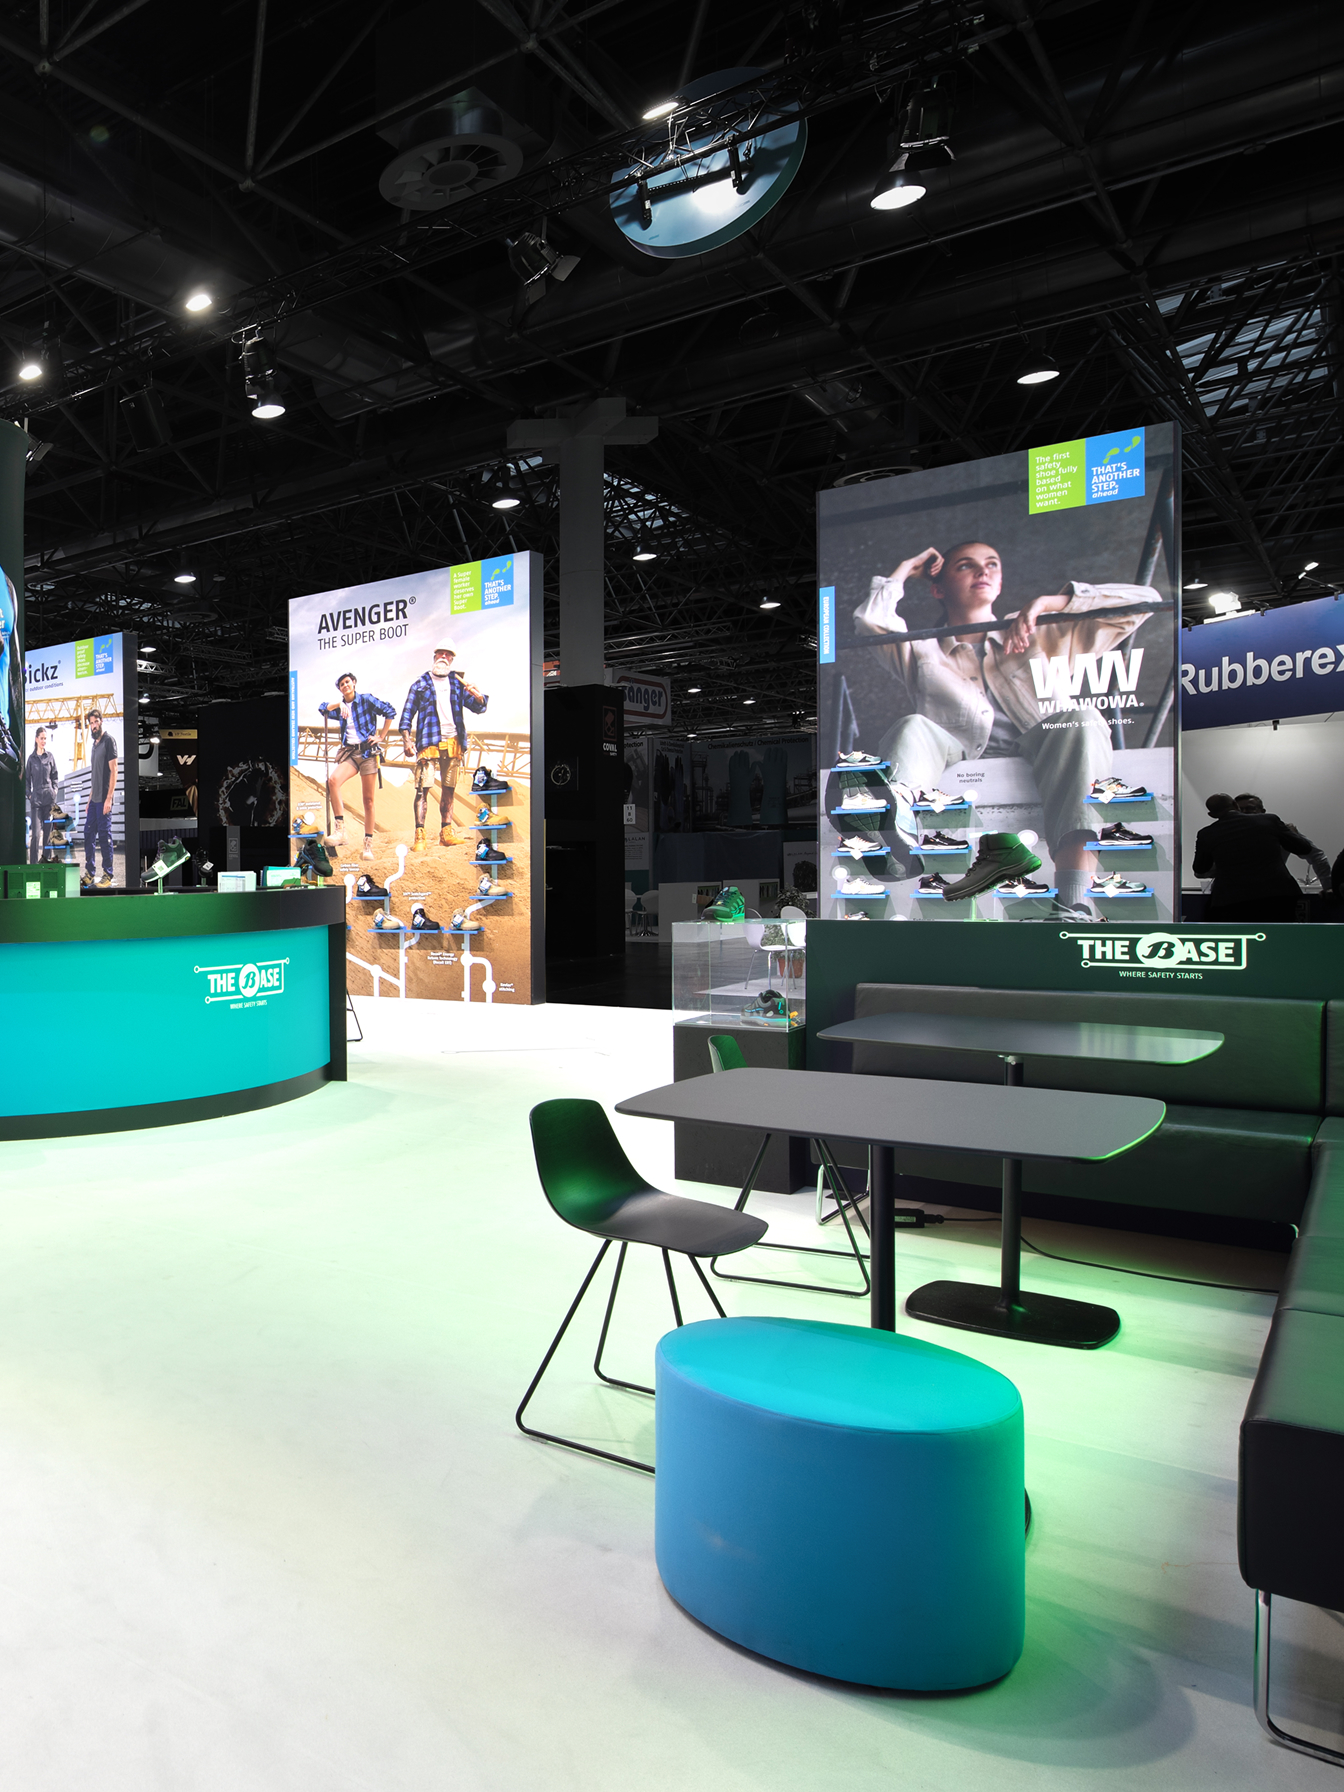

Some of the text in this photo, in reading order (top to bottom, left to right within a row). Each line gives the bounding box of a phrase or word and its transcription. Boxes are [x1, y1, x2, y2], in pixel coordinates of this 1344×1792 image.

[1053, 451, 1070, 460] first
[1036, 461, 1061, 471] safety
[1091, 462, 1127, 476] THAT’S
[1036, 465, 1078, 478] shoe fully
[1091, 468, 1140, 484] ANOTHER
[1036, 476, 1061, 486] based
[1050, 481, 1072, 491] what
[1091, 481, 1119, 492] STEP.
[1036, 490, 1068, 500] women
[1092, 489, 1118, 498] ahead
[1036, 498, 1061, 508] want.
[484, 579, 504, 588] THAT'S
[484, 584, 511, 595] ANOTHER
[484, 593, 500, 601] STEP.
[318, 624, 409, 650] THE SUPER BOOT
[1038, 694, 1144, 714] WHAWOWA.
[1042, 720, 1079, 729] Women’s
[603, 743, 617, 751] COVAL
[708, 740, 754, 750] Chemikalienschutz
[757, 738, 780, 746] Chemical
[1077, 938, 1235, 962] THE BASE
[207, 968, 280, 993] THE BASE
